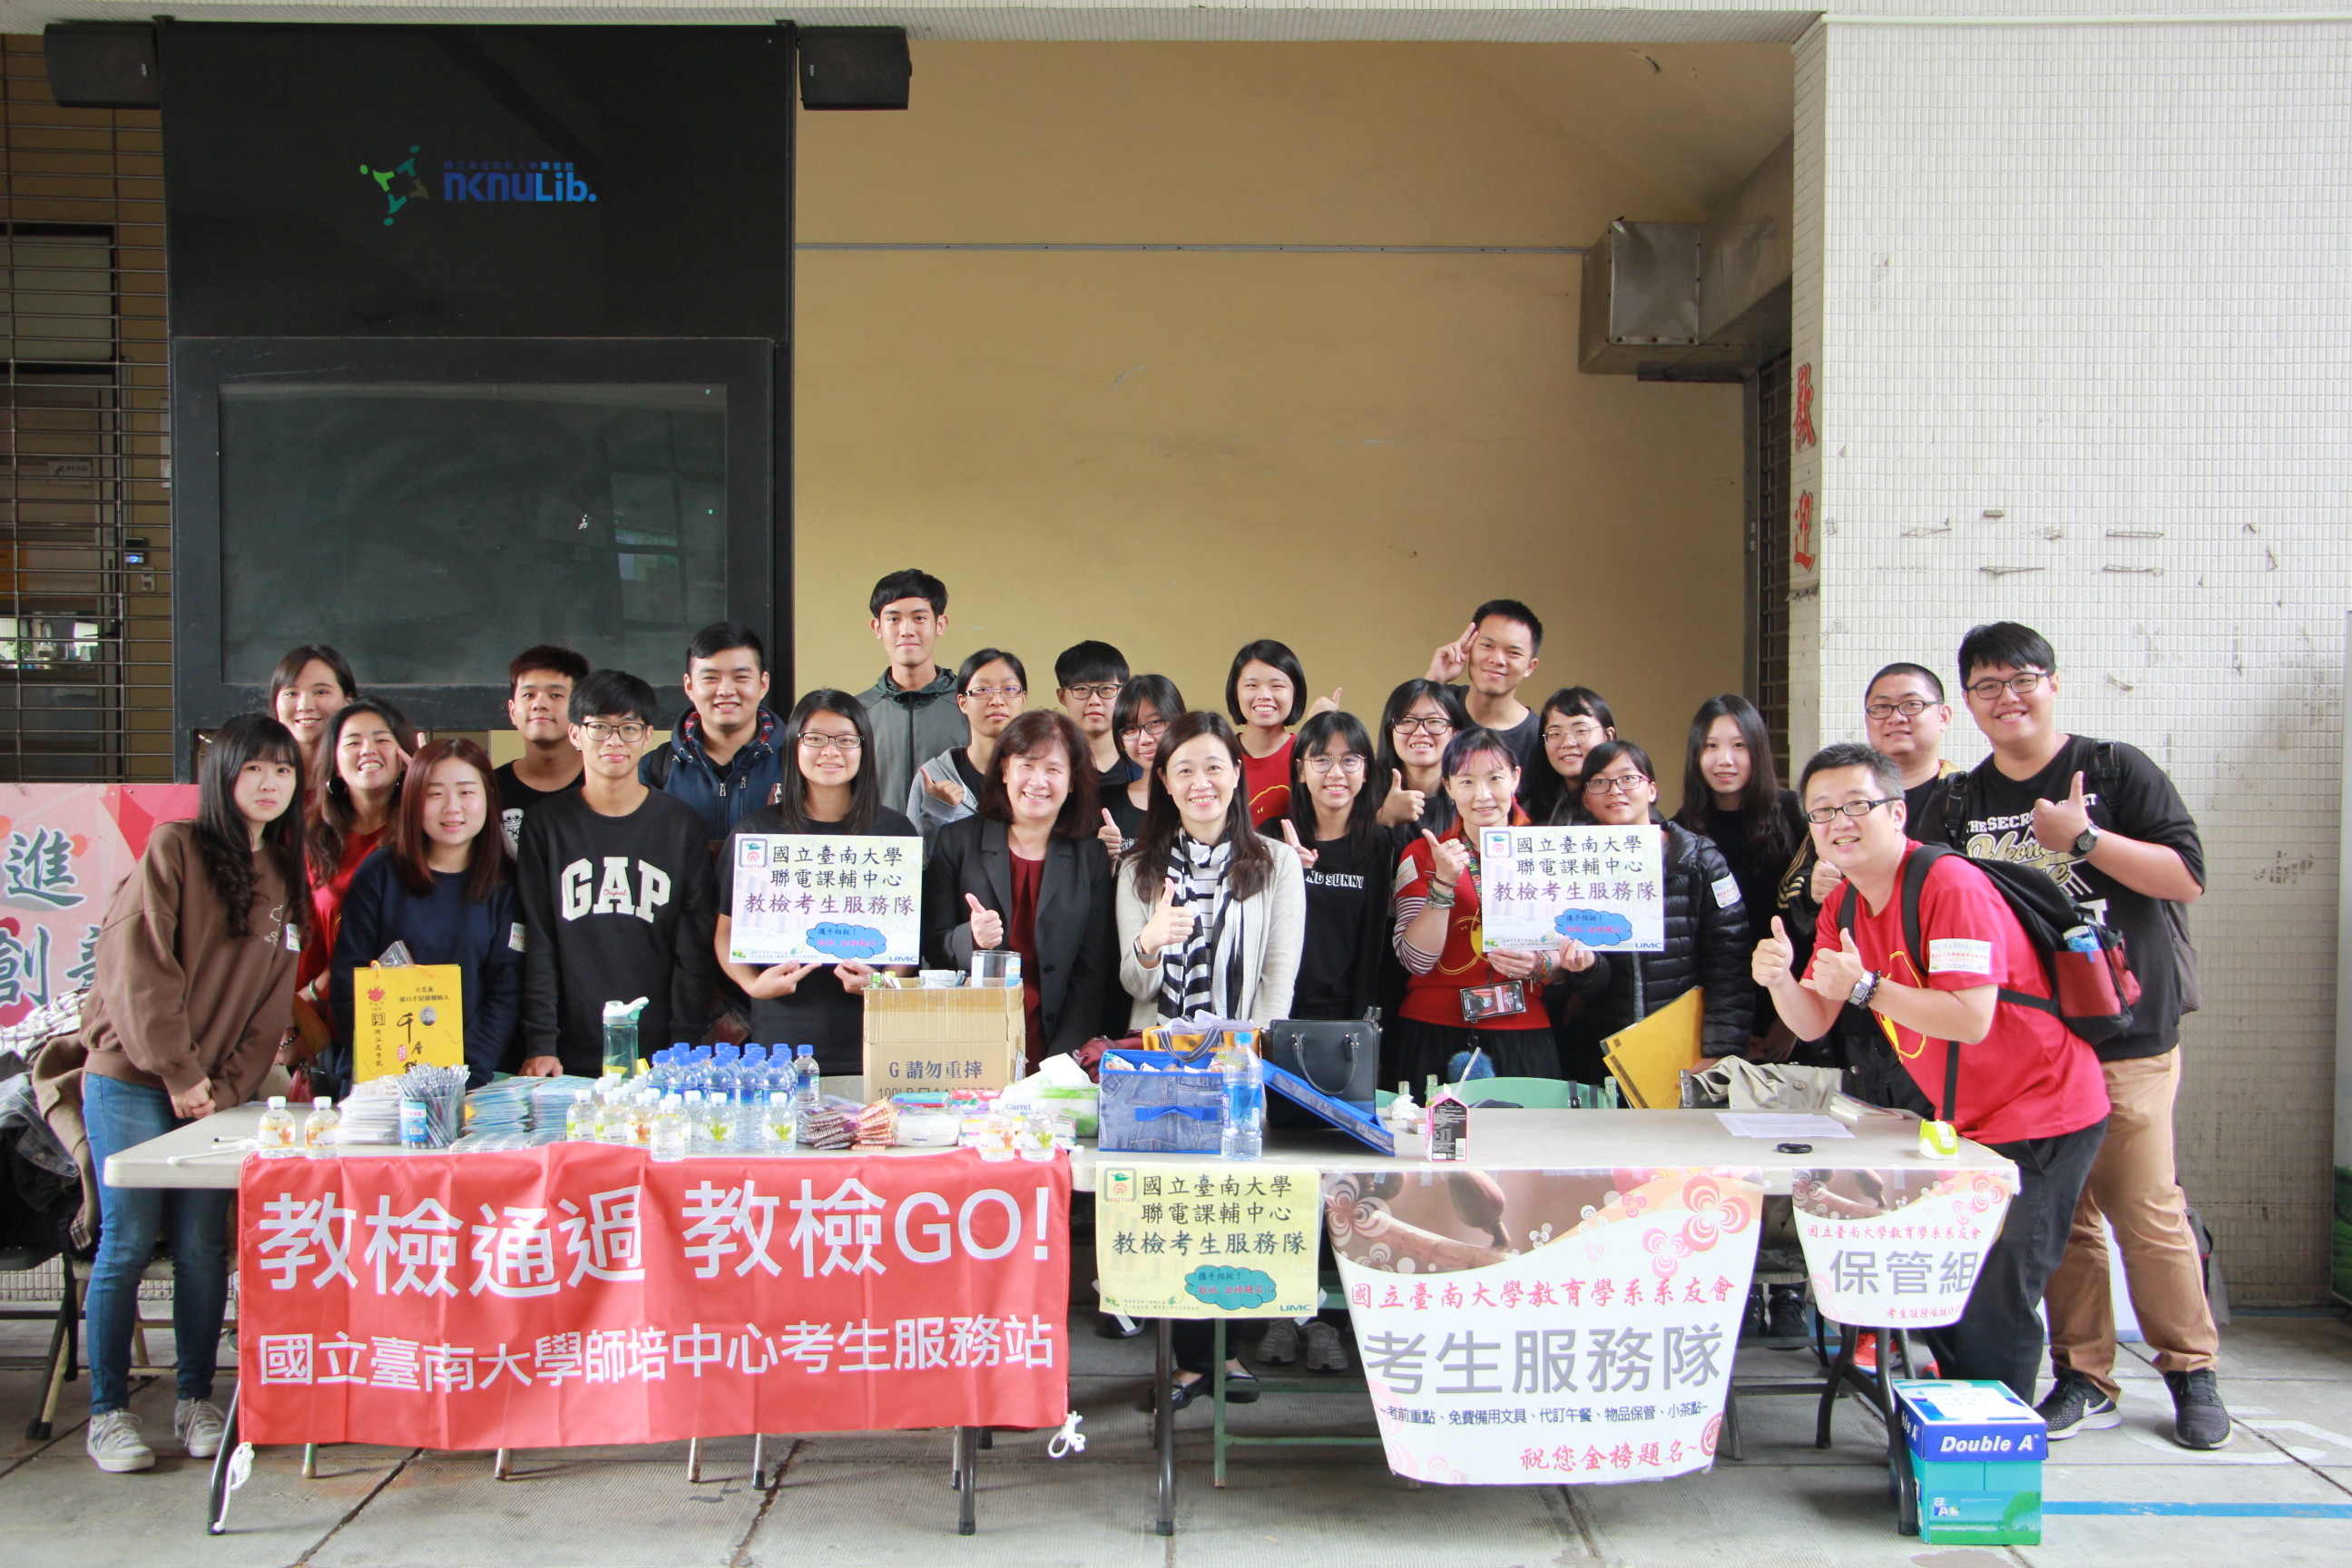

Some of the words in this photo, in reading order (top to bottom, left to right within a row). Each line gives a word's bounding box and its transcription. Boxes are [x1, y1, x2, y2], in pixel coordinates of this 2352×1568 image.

[773, 845, 903, 867] 國立臺南大學
[1516, 835, 1642, 855] 國立臺南大學
[4, 825, 87, 910] 進
[770, 869, 902, 888] 聯電課輔中心
[1516, 858, 1642, 877] 聯電課輔中心
[562, 857, 671, 923] GAP
[1325, 874, 1364, 888] SUNNY
[1493, 880, 1658, 902] 教檢考生服務隊
[744, 892, 916, 916] 教檢考生服務隊
[889, 1062, 899, 1078] G
[906, 1061, 983, 1079] 請勿重摔
[1142, 1173, 1292, 1198] 國立臺南大學
[1141, 1201, 1292, 1225] 聯電課輔中心
[259, 1184, 645, 1299] 教檢通過
[681, 1178, 1050, 1281] 教檢GO!
[1112, 1230, 1308, 1256] 教檢考生服務隊
[1807, 1225, 1982, 1240] 國立臺南大學教育學系系友會
[1828, 1249, 1979, 1295] 保管組
[1350, 1274, 1736, 1310] 國立臺南大學教育學系系友會
[259, 1313, 1054, 1393] 國立臺南大學師培中心考生服務站
[1364, 1322, 1723, 1395] 考生服務隊
[1940, 1436, 2012, 1452] Double
[2017, 1435, 2034, 1451] A
